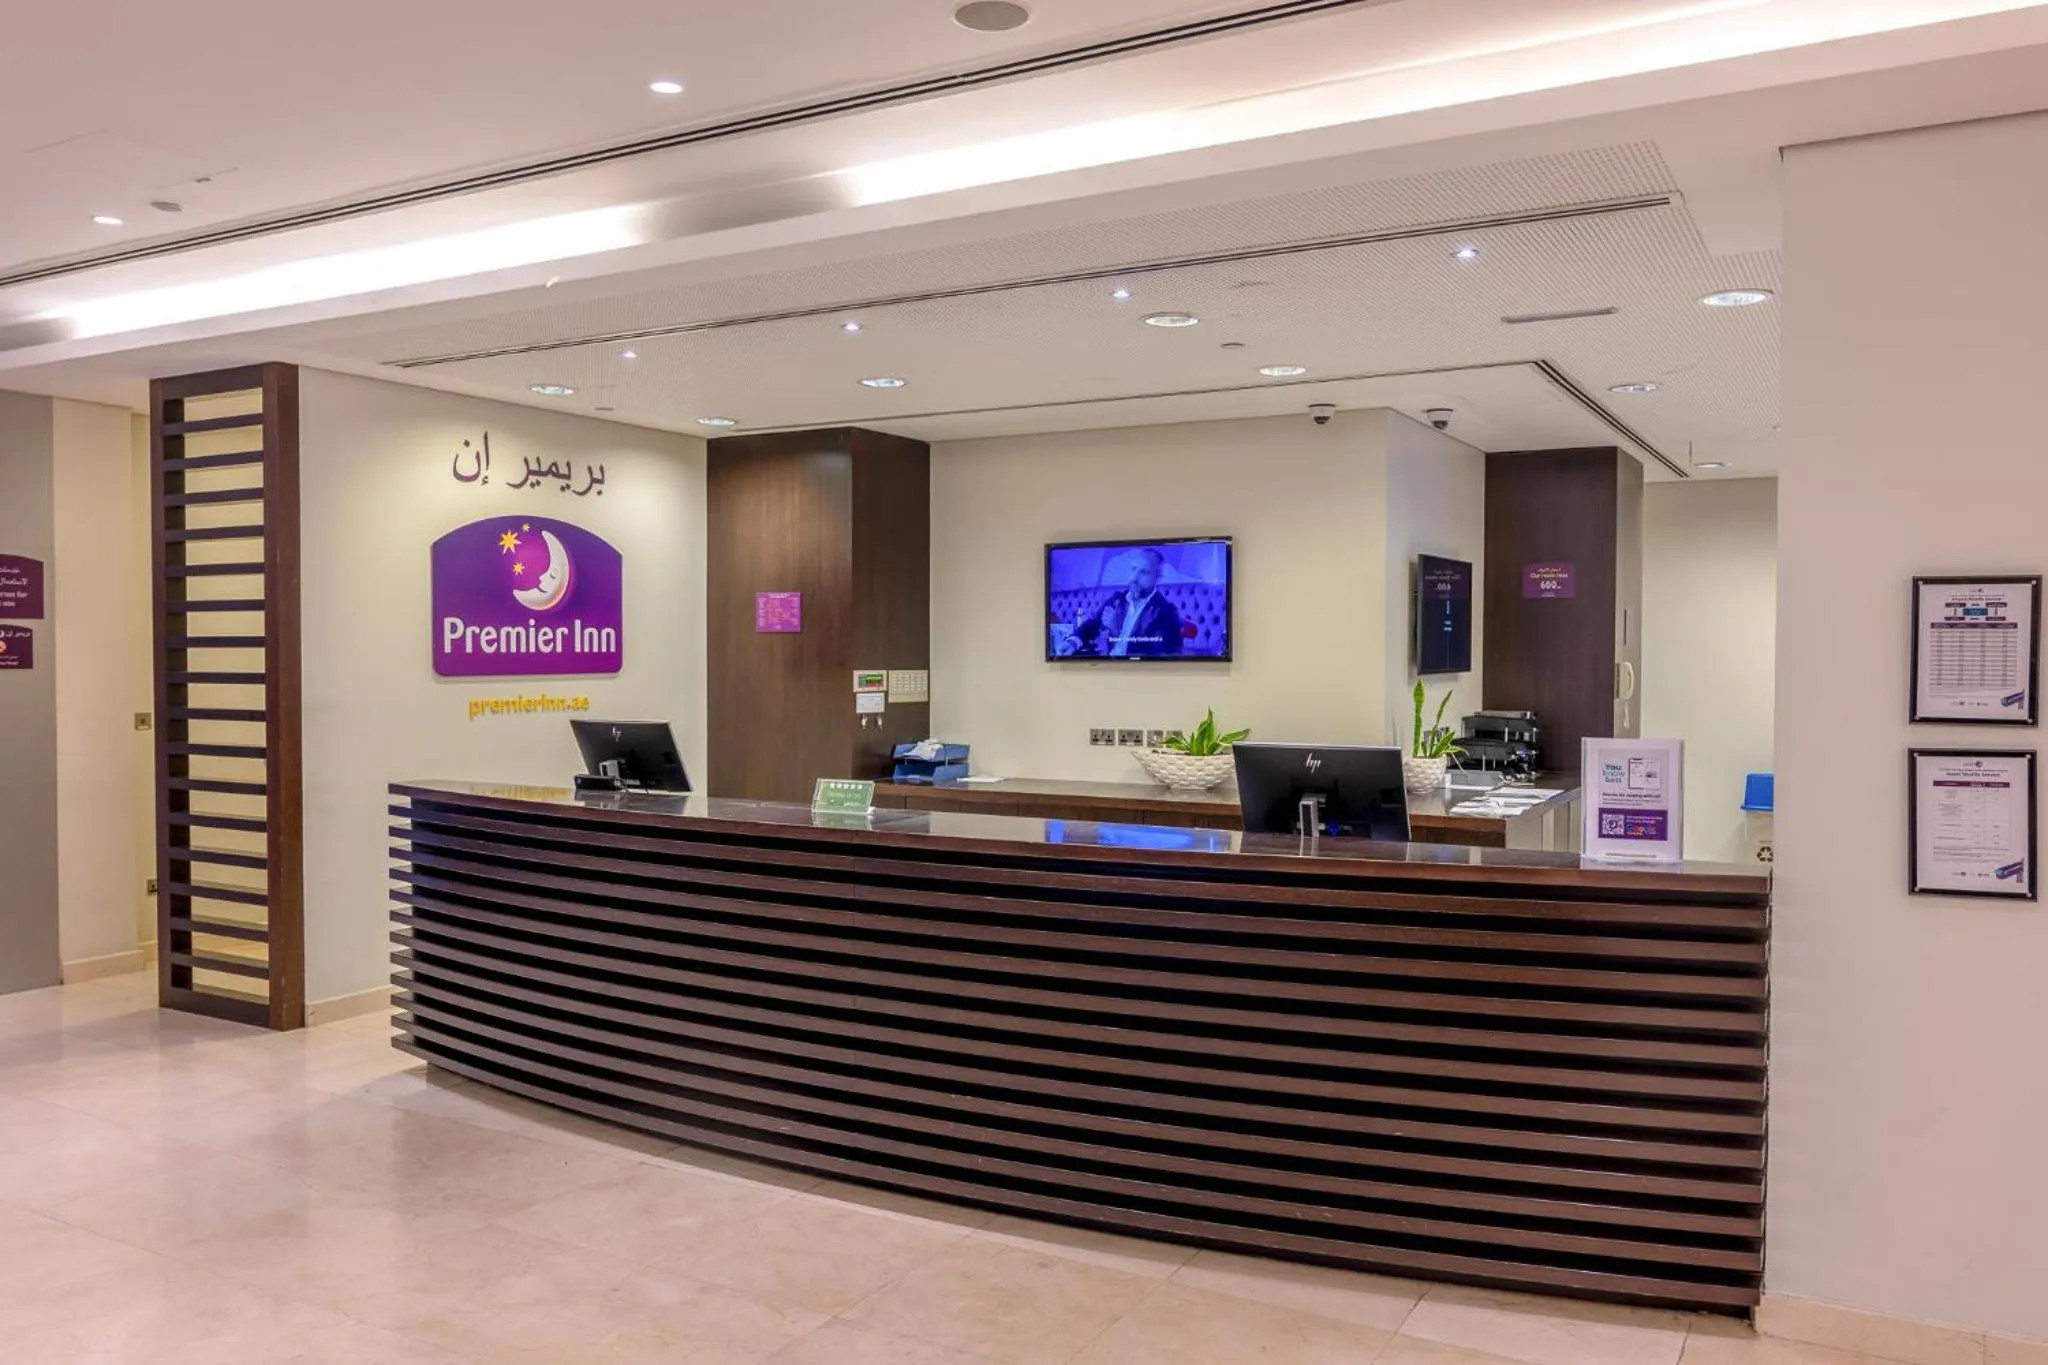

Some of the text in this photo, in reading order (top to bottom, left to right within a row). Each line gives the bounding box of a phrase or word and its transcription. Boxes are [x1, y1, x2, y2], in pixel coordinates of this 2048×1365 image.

[452, 430, 605, 496] بريمير إن
[443, 616, 617, 654] Premier Inn
[468, 693, 590, 721] premierinn.ae
[1305, 752, 1323, 774] hp
